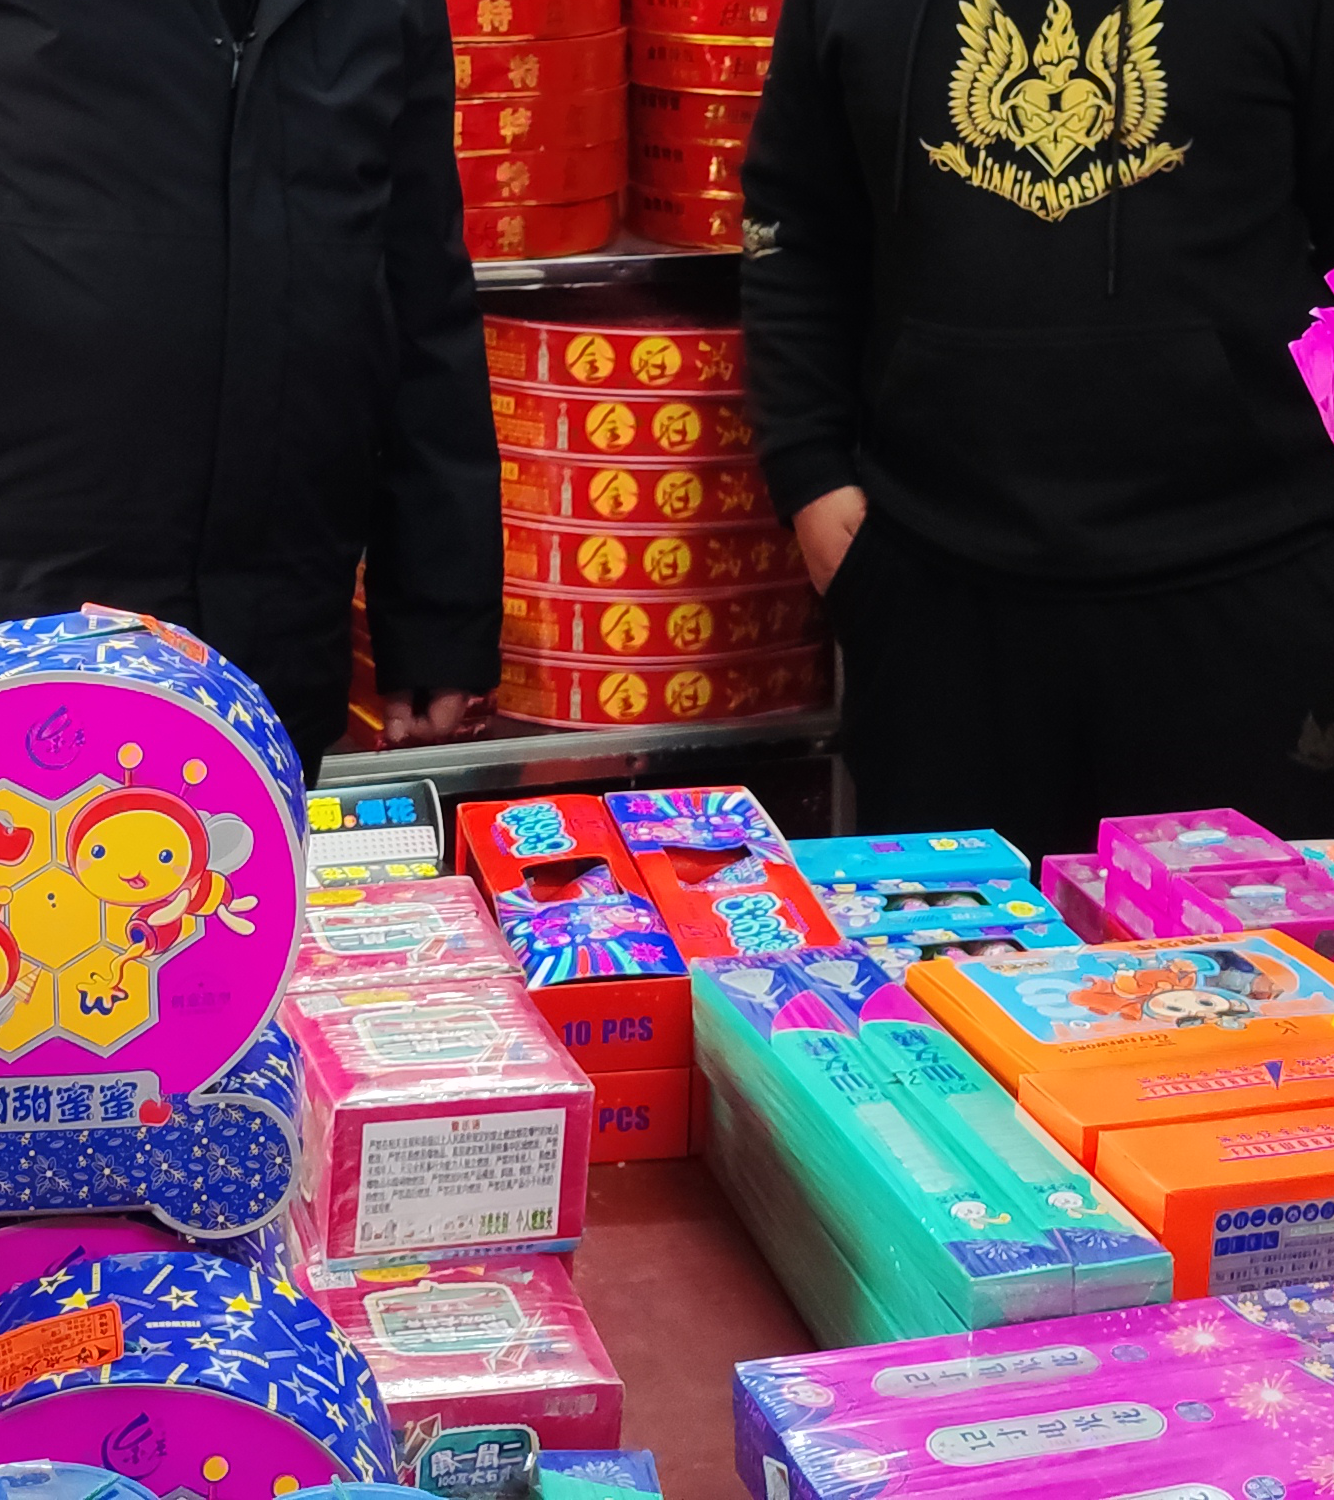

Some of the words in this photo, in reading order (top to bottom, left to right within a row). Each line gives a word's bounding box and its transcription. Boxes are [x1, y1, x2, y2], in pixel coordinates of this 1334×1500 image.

[563, 1020, 591, 1047] 10
[602, 1016, 654, 1044] PCS
[599, 1104, 651, 1133] PCS
